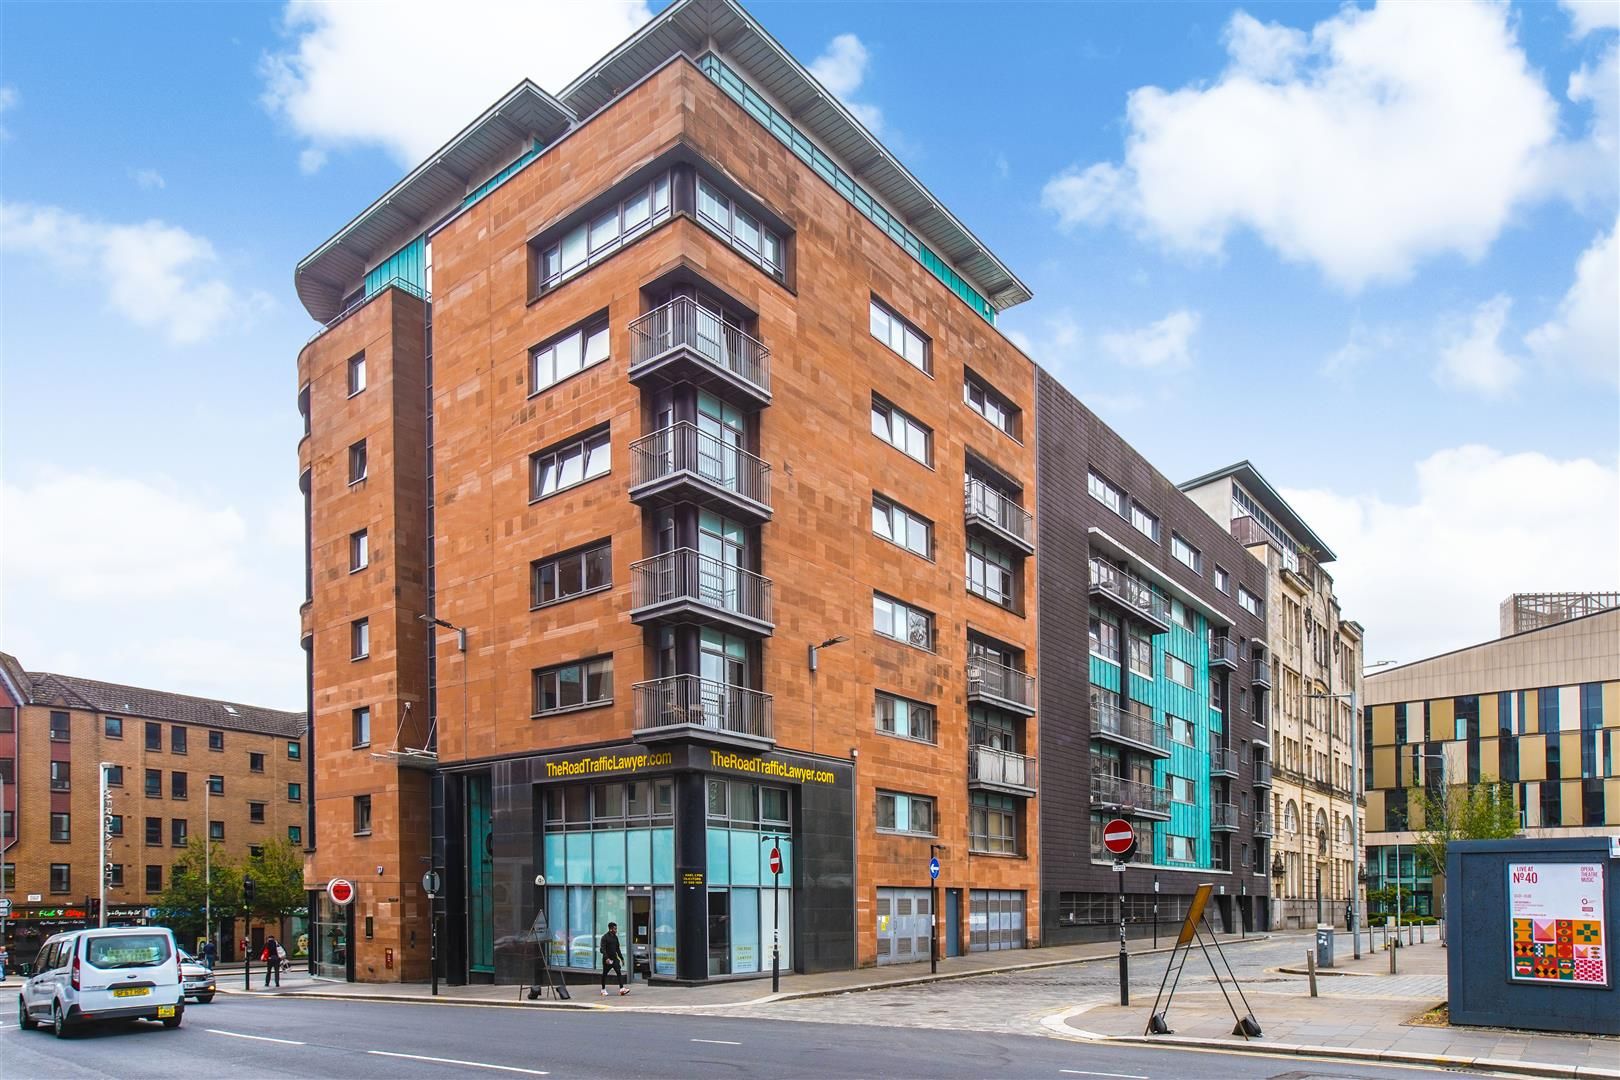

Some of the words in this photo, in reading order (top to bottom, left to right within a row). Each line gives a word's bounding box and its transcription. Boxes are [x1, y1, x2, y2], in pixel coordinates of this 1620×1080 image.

[546, 752, 672, 777] TheRoadTrafficLawyer.com
[710, 750, 835, 784] TheRoadTrafficLawyer.com
[104, 789, 114, 859] MERCHANT
[105, 862, 114, 890] CITY
